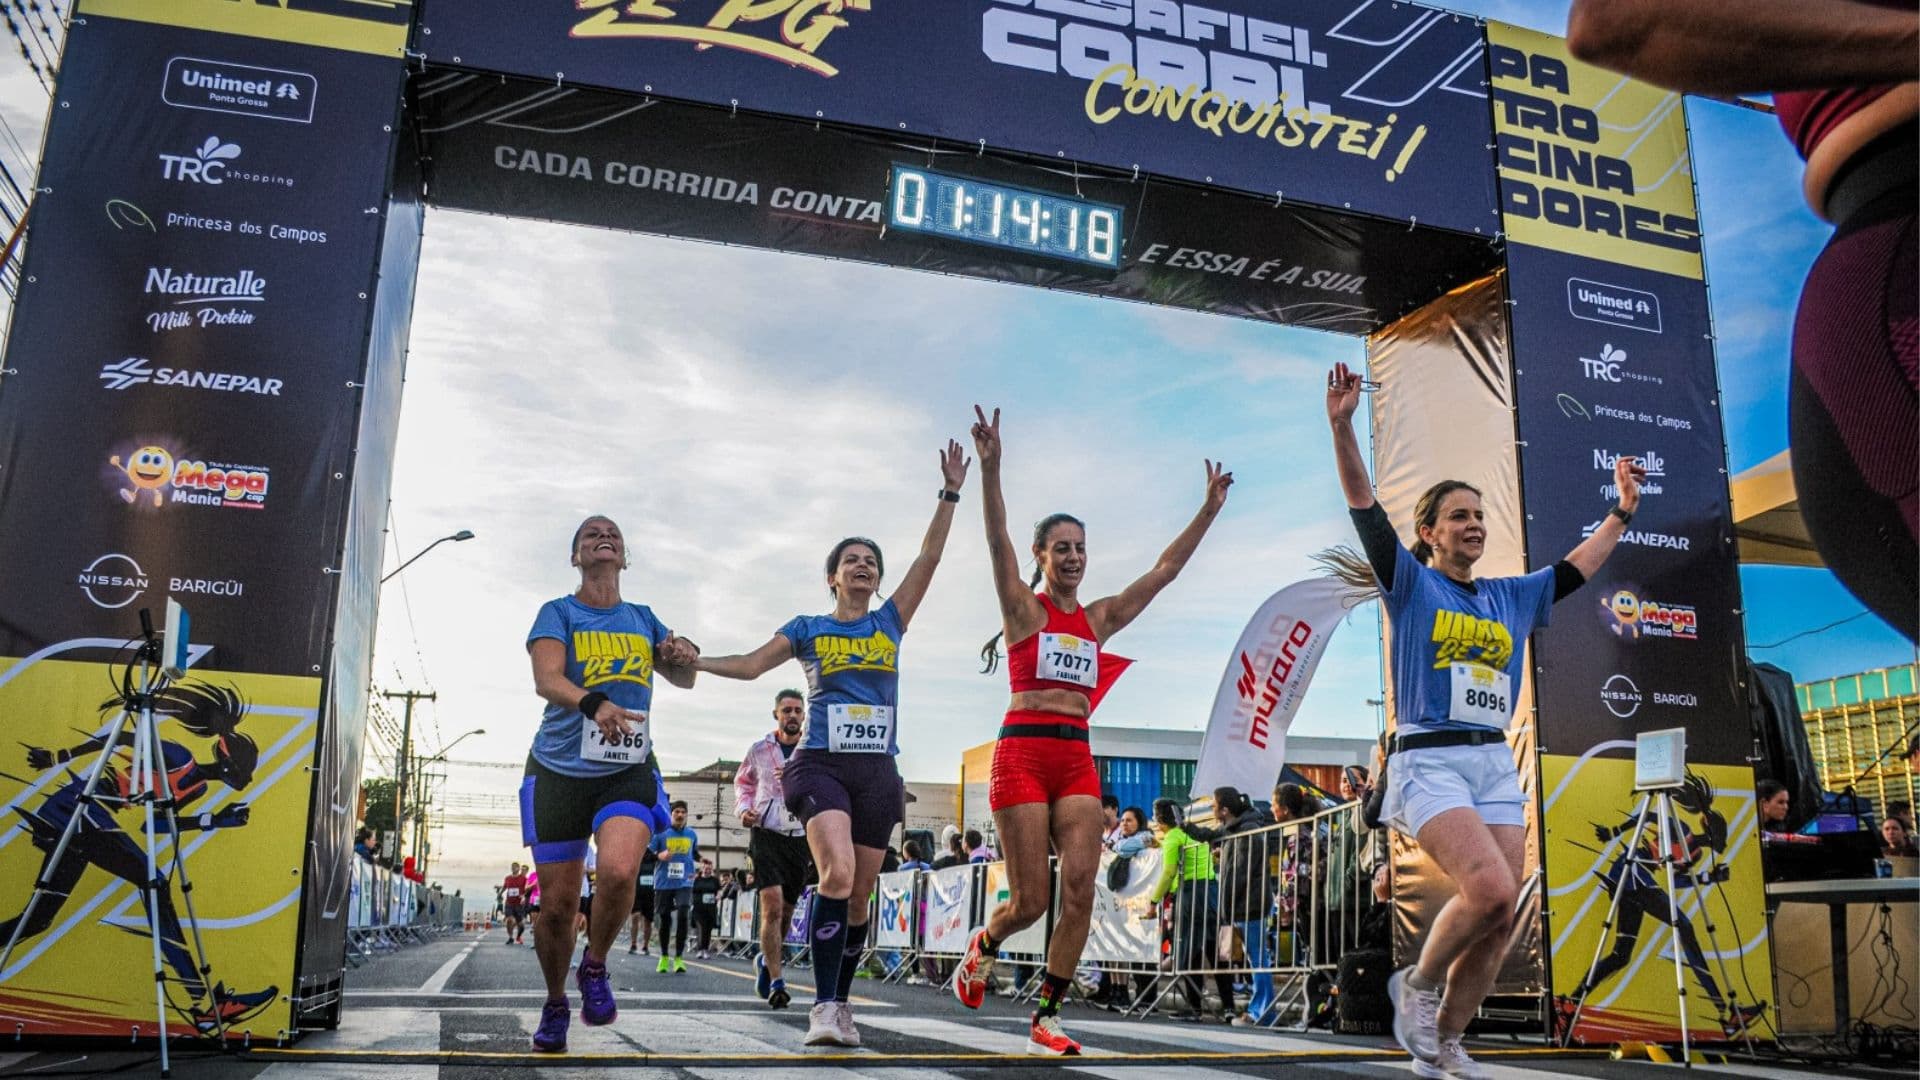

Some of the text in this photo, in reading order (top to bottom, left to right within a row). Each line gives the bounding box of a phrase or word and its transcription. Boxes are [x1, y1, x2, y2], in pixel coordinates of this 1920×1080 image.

[992, 0, 1328, 68] SAFIEI.
[182, 69, 272, 96] Unimed
[1489, 43, 1570, 95] PA
[209, 92, 268, 108] Ponta Grossa
[1492, 86, 1600, 145] TRO
[159, 153, 294, 187] TRC shopping
[1496, 132, 1635, 197] CINA
[494, 145, 883, 224] CADA CORRIDA CONTA
[895, 170, 1114, 263] 01:14:18
[1499, 175, 1700, 254] DORES
[239, 221, 263, 235] dos
[270, 224, 328, 244] Campos
[144, 267, 266, 296] Naturalle
[1138, 243, 1168, 263] E
[1165, 247, 1250, 276] ESSA
[1248, 259, 1282, 281] É
[1273, 266, 1304, 284] A
[1302, 270, 1368, 295] SUA.
[1578, 288, 1633, 311] Unimed
[147, 308, 256, 333] Milk Protein
[153, 367, 283, 396] SANEPAR
[1579, 356, 1622, 383] TRC
[1638, 412, 1653, 423] dos
[1656, 415, 1692, 431] Campos
[1593, 449, 1665, 472] Naalle
[171, 459, 269, 501] Mega
[172, 489, 222, 506] Mania
[246, 494, 265, 504] cap
[79, 574, 243, 596] NISSAN BARIGÜI
[1640, 601, 1696, 633] Mega
[1643, 624, 1672, 638] Mania
[1053, 652, 1092, 673] 7077
[1249, 620, 1312, 751] muraro
[1600, 690, 1643, 702] NISSAN
[1465, 688, 1506, 713] 8096
[843, 723, 888, 740] 7967
[602, 750, 630, 761] JANETE
